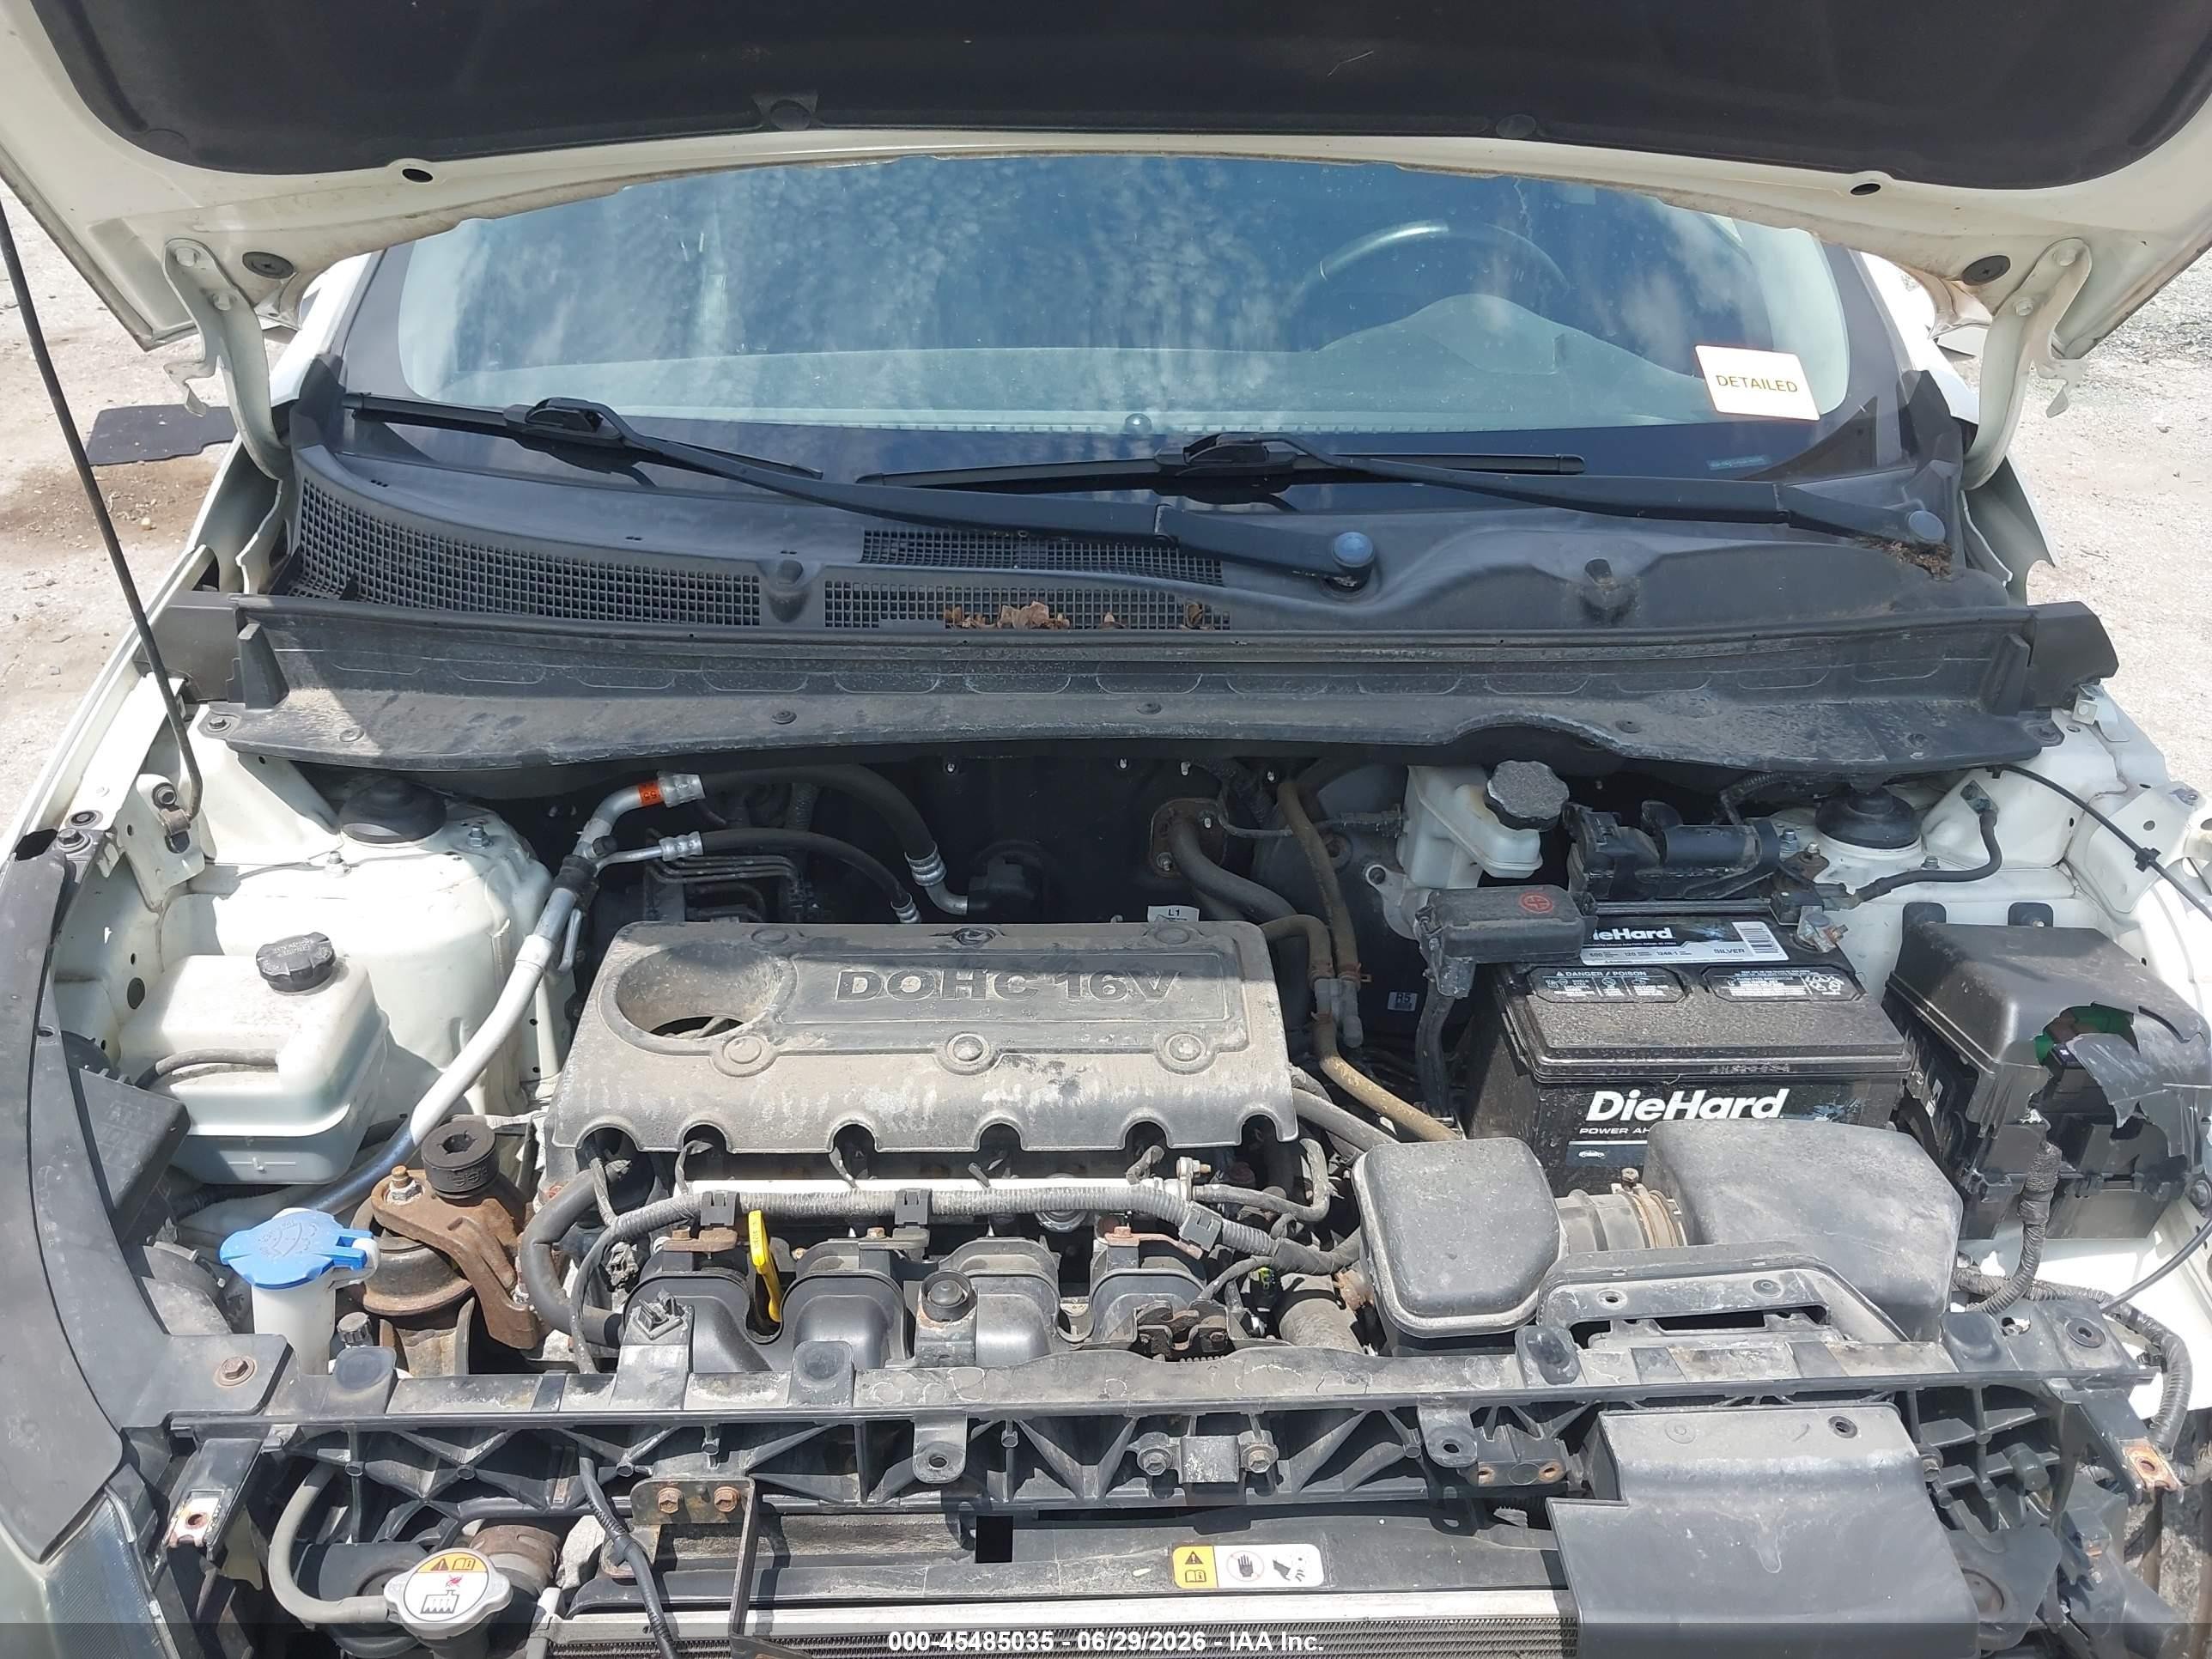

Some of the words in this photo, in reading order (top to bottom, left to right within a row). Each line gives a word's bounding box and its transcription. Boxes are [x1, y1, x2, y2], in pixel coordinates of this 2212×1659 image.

[1716, 375, 1798, 392] DETAILED
[1168, 908, 1181, 917] L1
[1589, 927, 1674, 940] ieHard
[836, 969, 1039, 1002] DOHC
[1054, 969, 1181, 1002] 16V
[1585, 1088, 1790, 1121] DieHard
